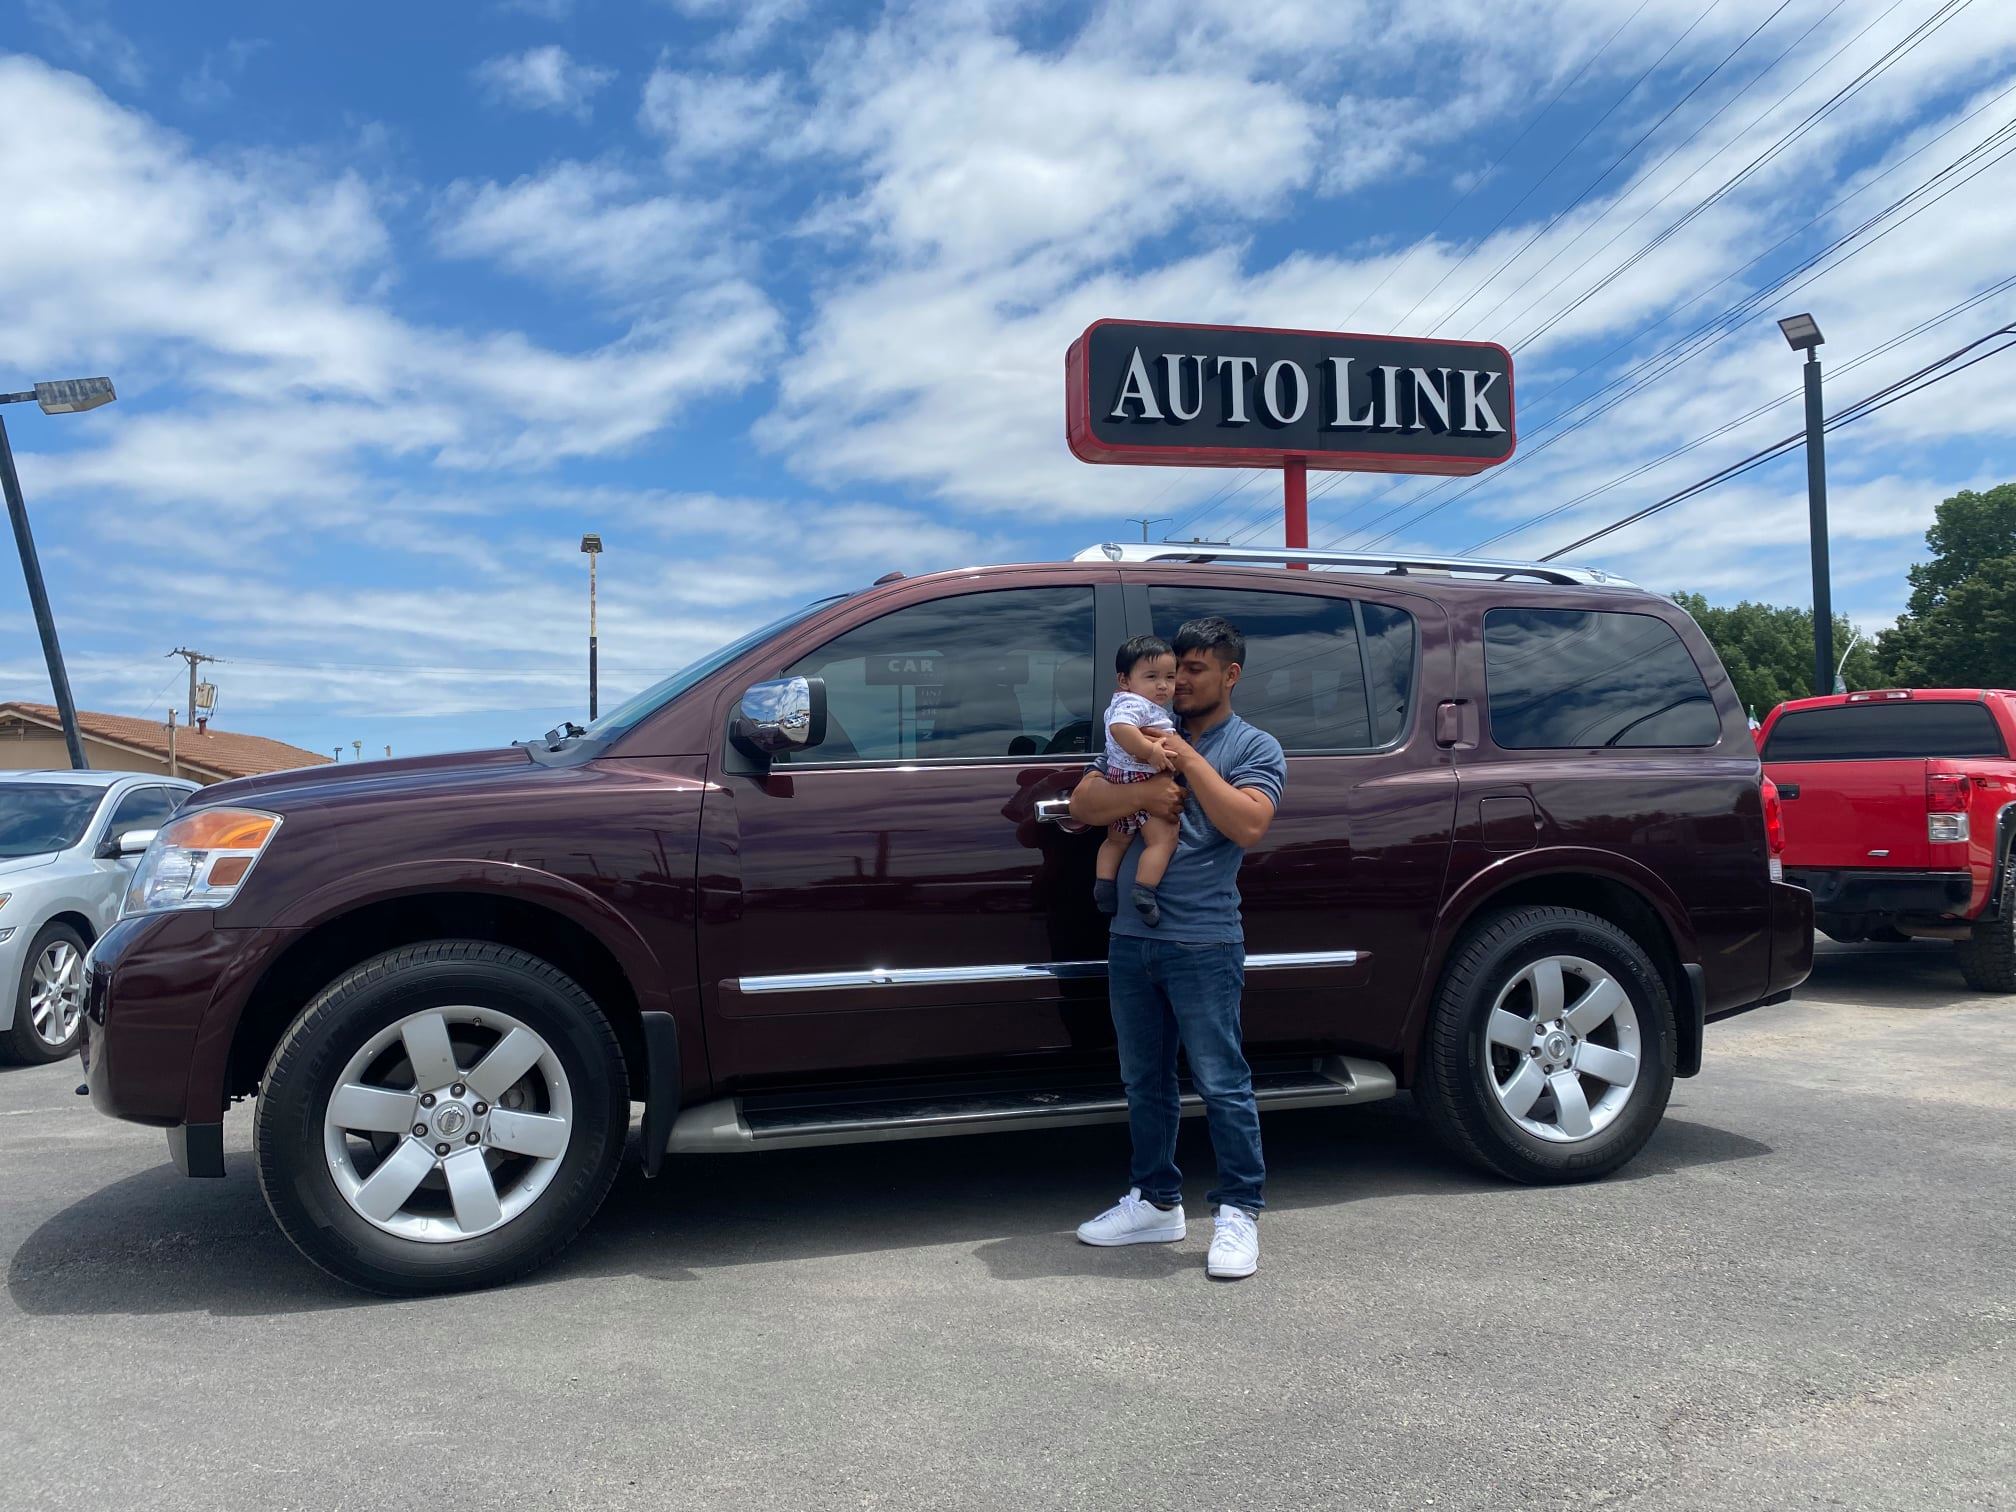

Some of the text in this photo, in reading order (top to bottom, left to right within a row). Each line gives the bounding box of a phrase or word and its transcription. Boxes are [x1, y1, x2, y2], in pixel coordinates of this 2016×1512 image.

[1111, 346, 1507, 433] AUTO LINK
[888, 659, 934, 672] CAR
